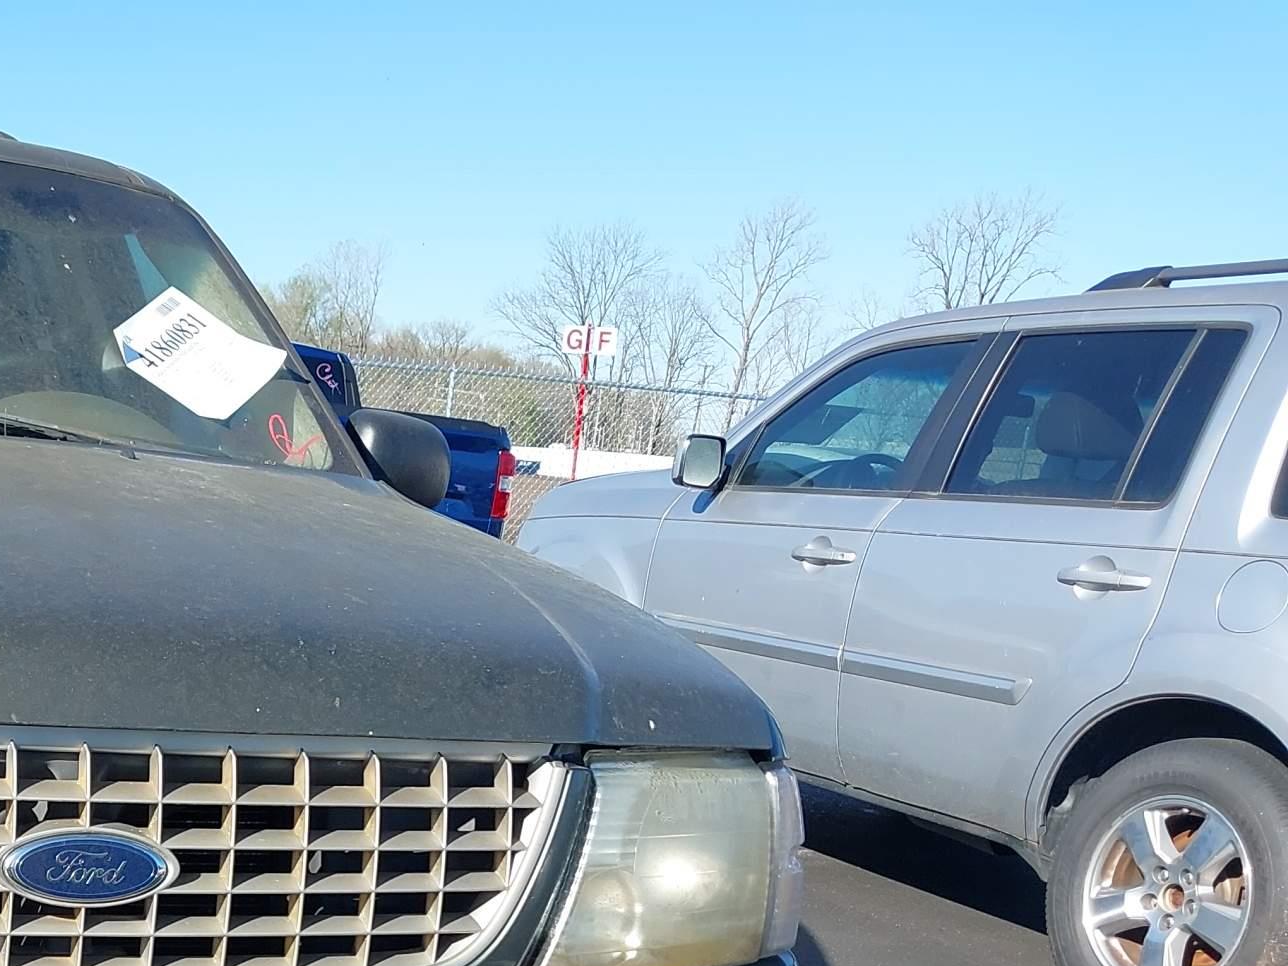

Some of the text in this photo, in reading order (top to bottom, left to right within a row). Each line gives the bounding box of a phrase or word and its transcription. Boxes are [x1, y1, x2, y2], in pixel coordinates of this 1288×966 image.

[139, 313, 207, 368] 41860831
[566, 329, 613, 351] G F
[46, 849, 127, 885] Ford
